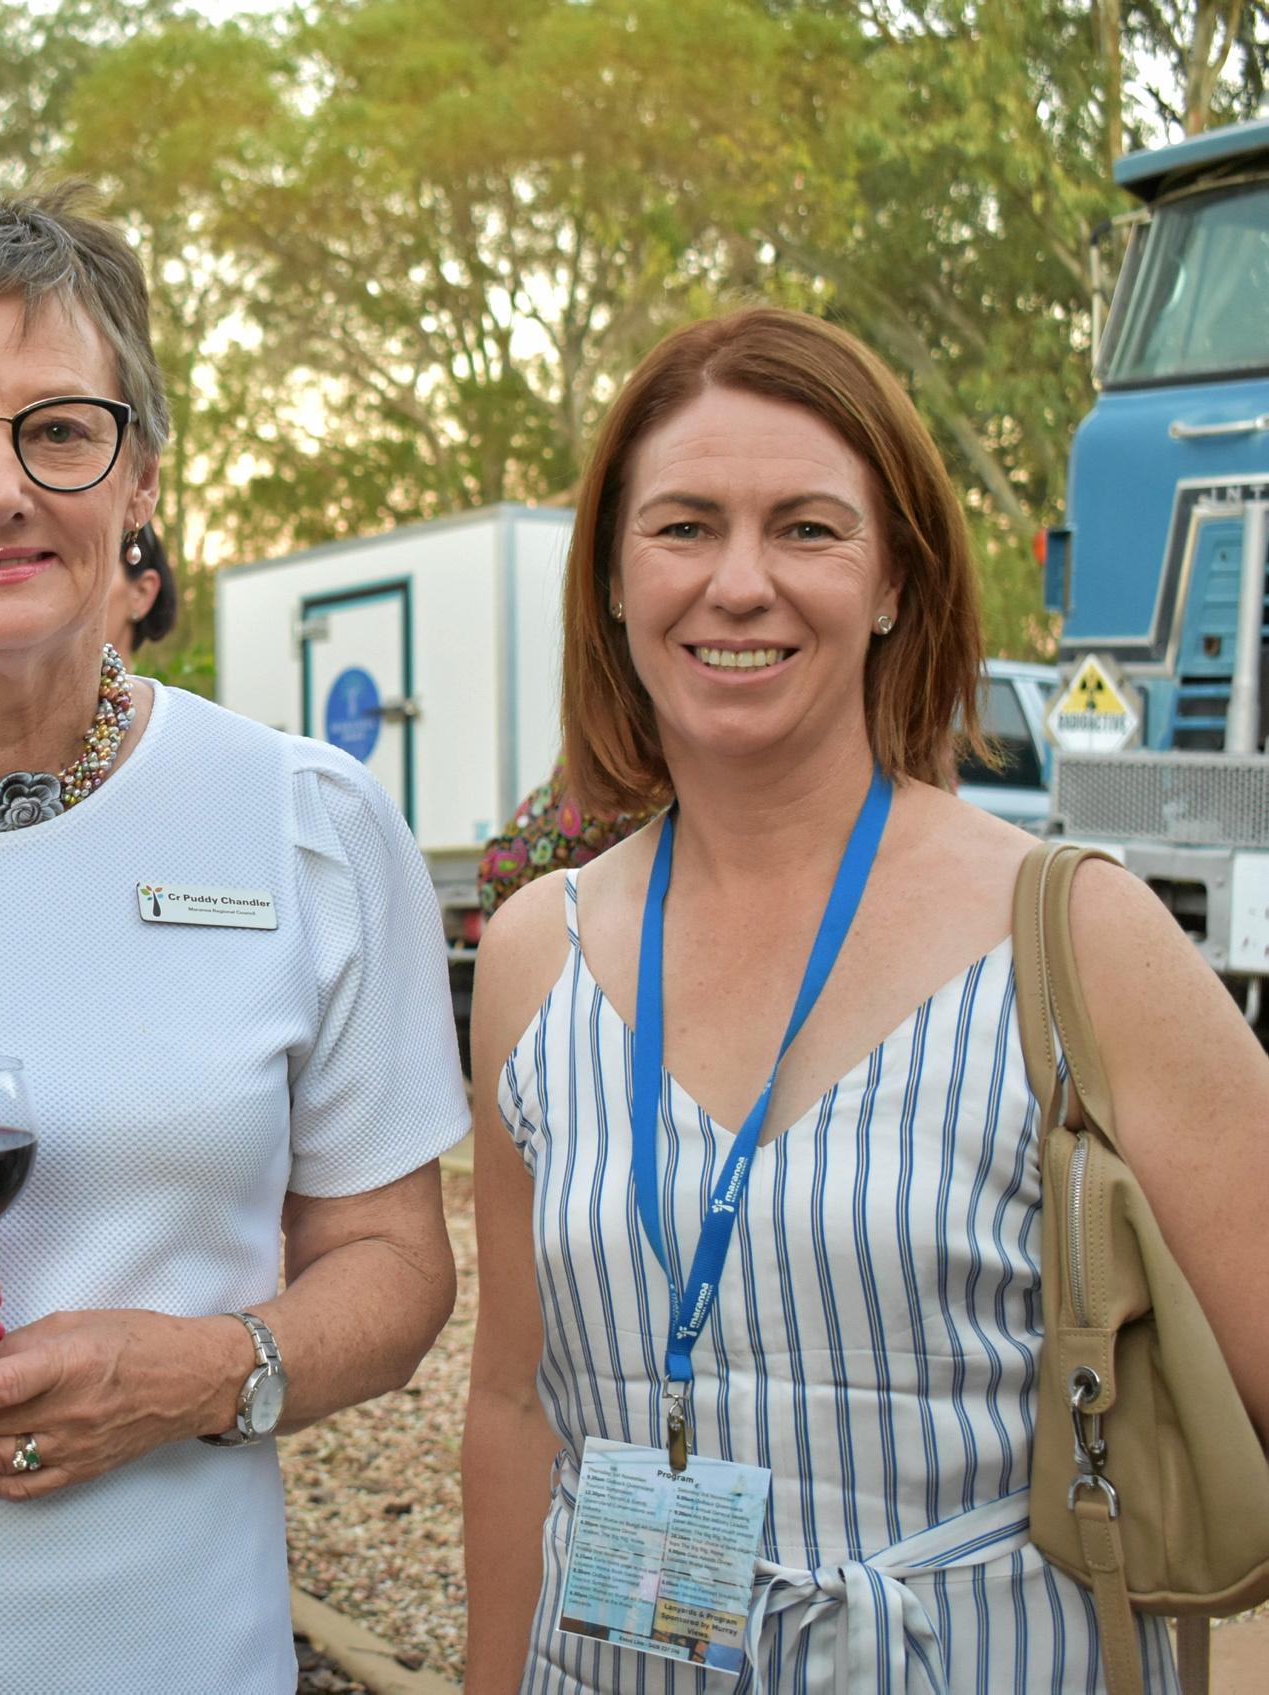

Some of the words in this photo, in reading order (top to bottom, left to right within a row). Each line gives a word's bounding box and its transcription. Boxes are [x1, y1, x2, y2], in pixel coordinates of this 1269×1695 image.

[168, 893, 180, 901] Cr
[183, 894, 218, 905] Puddy
[221, 896, 271, 907] Chandler
[725, 1156, 745, 1202] maranoa
[690, 1282, 709, 1328] maranoa
[657, 1470, 694, 1485] Program
[661, 1613, 700, 1628] Sponsored
[701, 1621, 710, 1630] by
[712, 1623, 738, 1636] Murray
[664, 1604, 697, 1617] Lanyards
[699, 1611, 704, 1619] &
[706, 1613, 738, 1626] Program
[687, 1628, 708, 1638] Views
